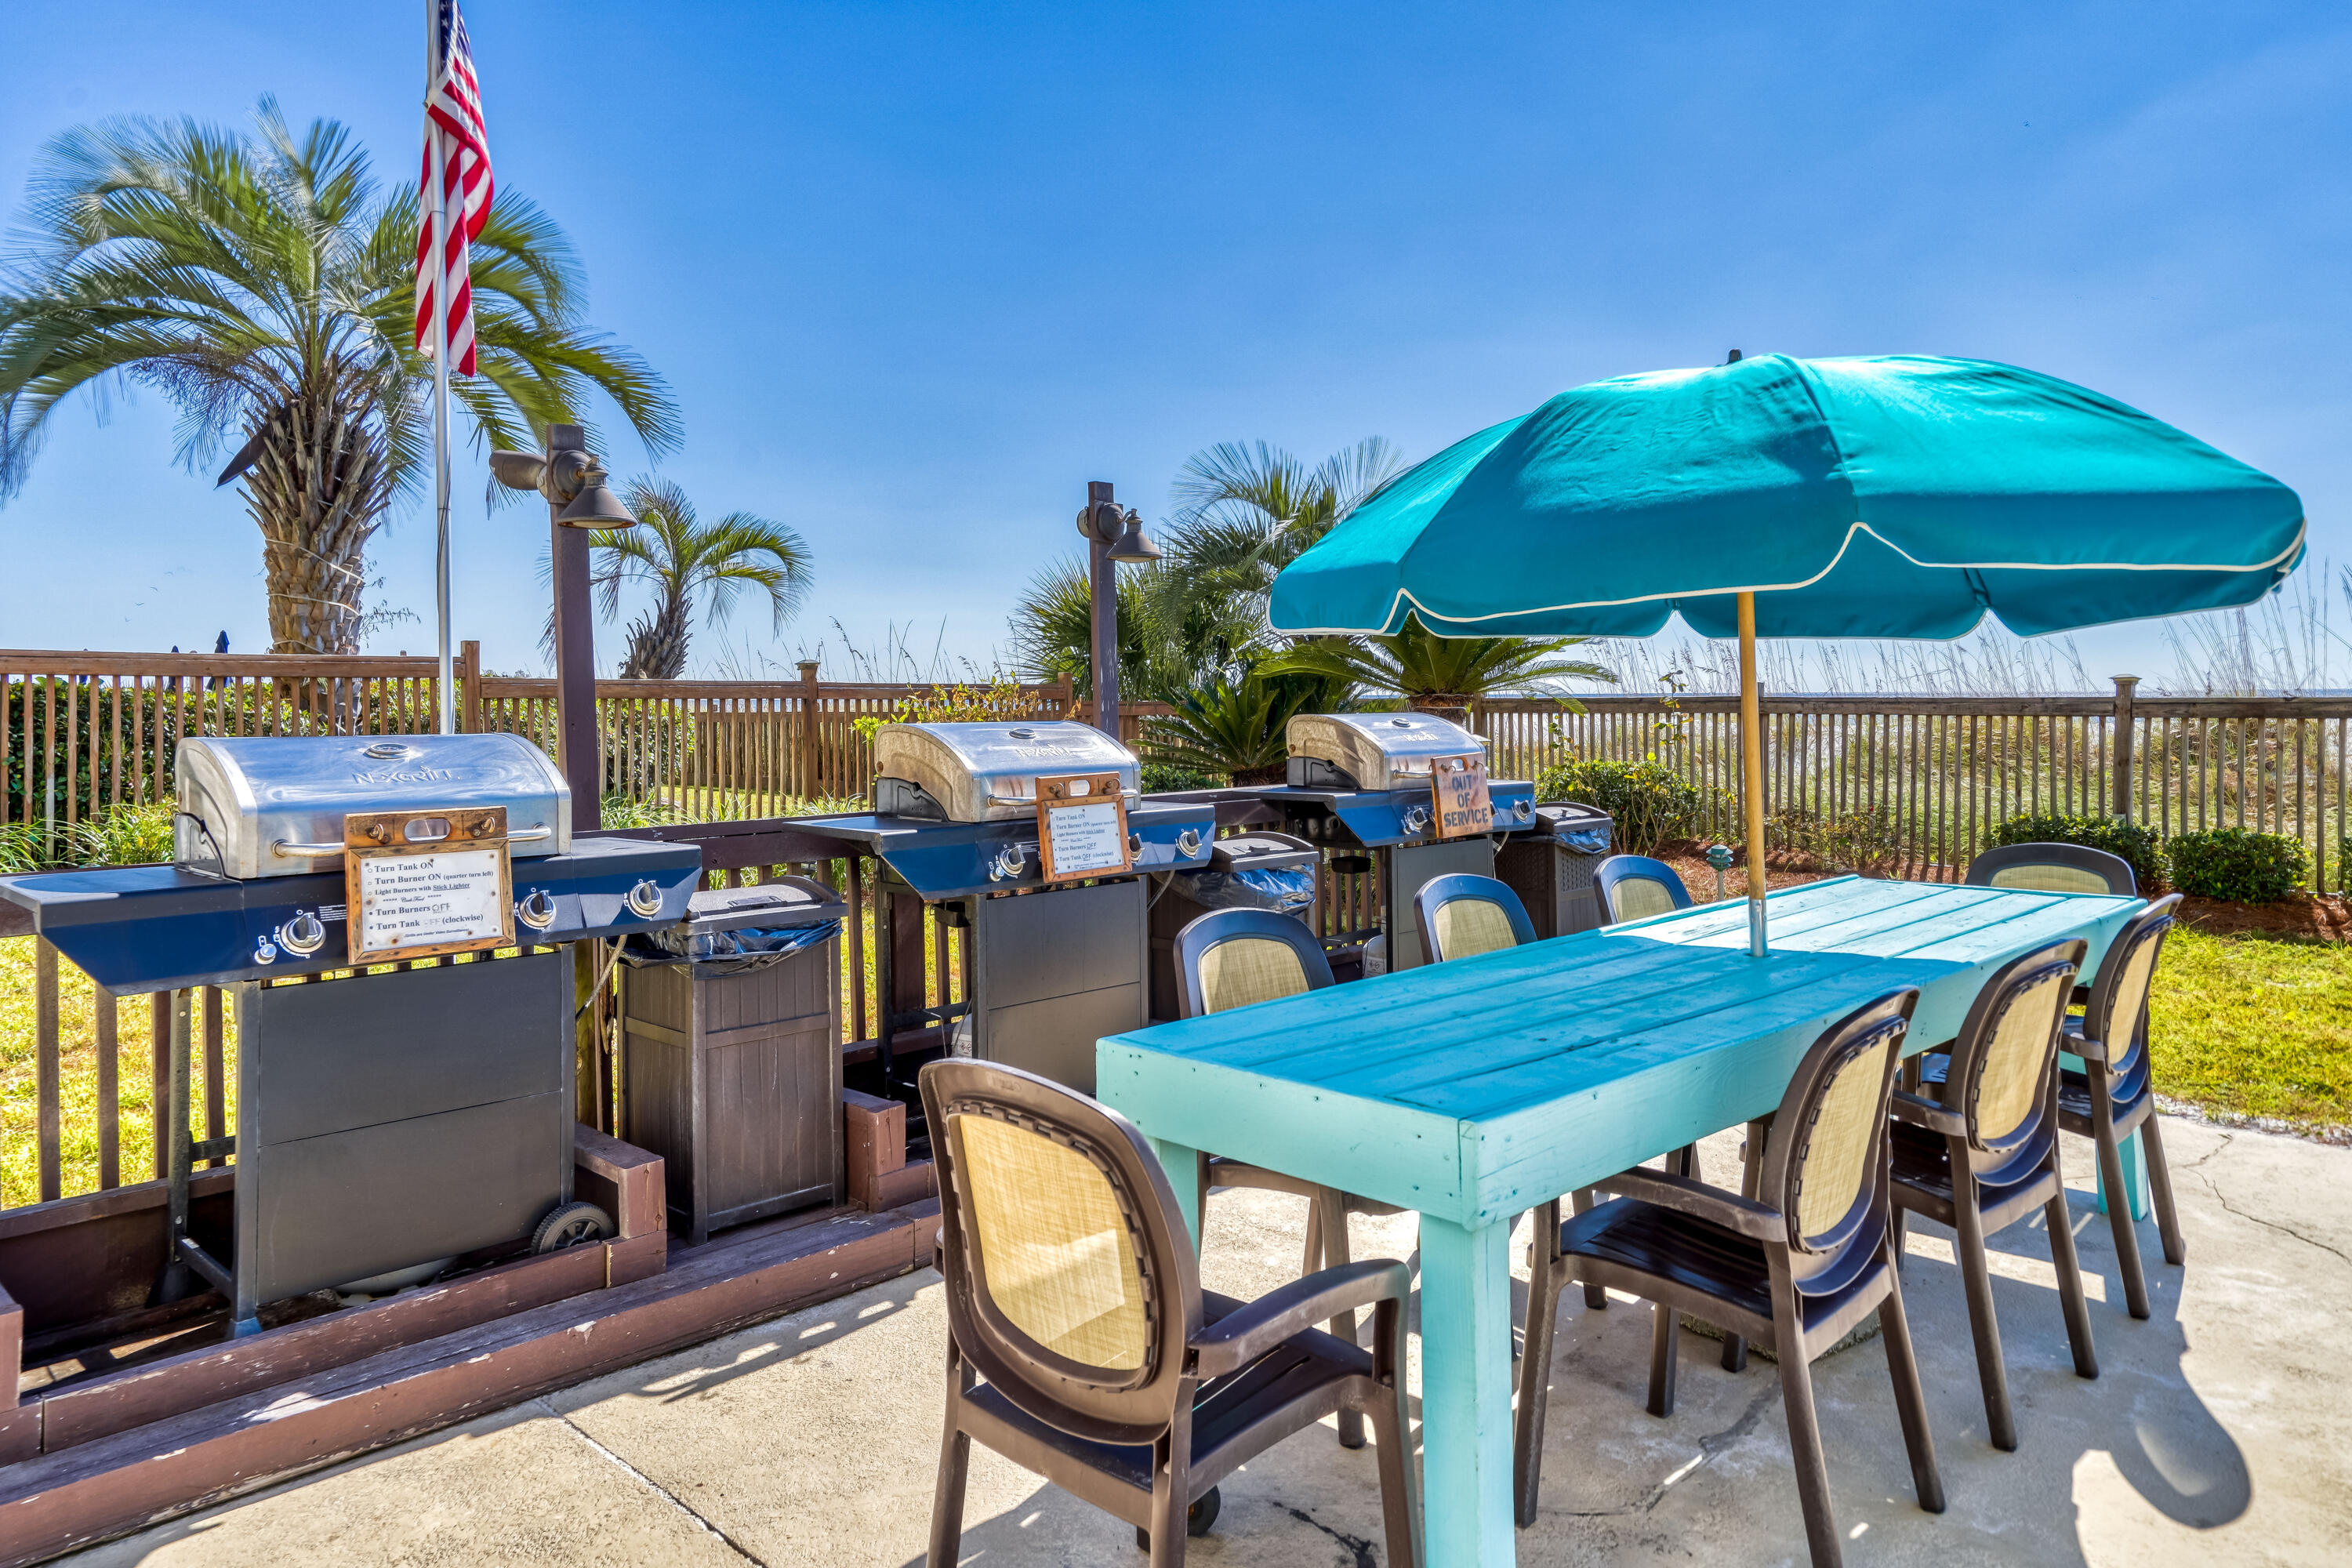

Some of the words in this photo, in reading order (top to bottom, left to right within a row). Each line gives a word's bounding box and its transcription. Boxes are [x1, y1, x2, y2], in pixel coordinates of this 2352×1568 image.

[352, 765, 461, 784] NXGRILL
[1452, 775, 1472, 791] OUT
[1457, 792, 1470, 808] OF
[1443, 808, 1489, 828] SERVICE
[397, 862, 418, 871] Tank
[397, 875, 426, 884] Burner
[428, 873, 441, 881] ON
[398, 906, 431, 914] Burners
[432, 902, 450, 912] OFF
[442, 913, 484, 924] (clockwise)
